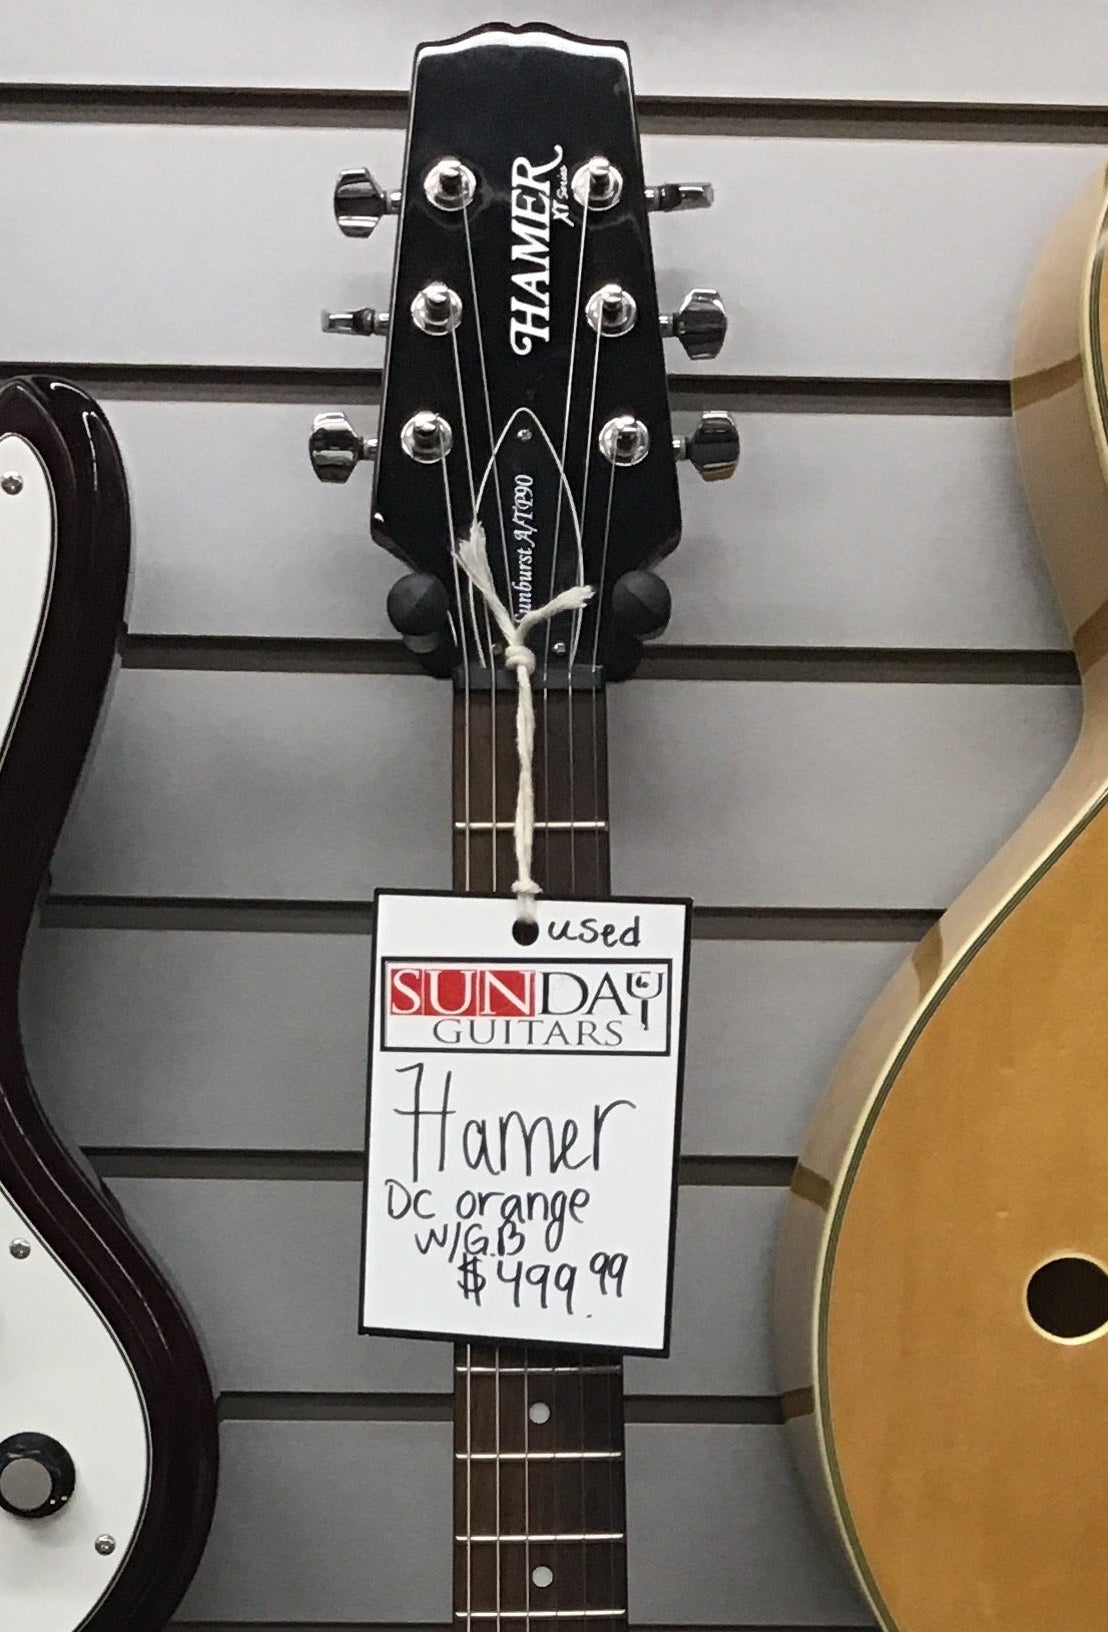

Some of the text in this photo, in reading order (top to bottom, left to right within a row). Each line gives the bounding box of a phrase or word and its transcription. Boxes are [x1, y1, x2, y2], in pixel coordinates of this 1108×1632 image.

[551, 164, 574, 227] XT Series
[510, 145, 563, 356] HAMER
[548, 916, 641, 947] used
[390, 968, 665, 1031] SUNDAY
[432, 1018, 623, 1047] GUITARS
[393, 1062, 636, 1182] Hamer
[456, 1188, 590, 1252] orange
